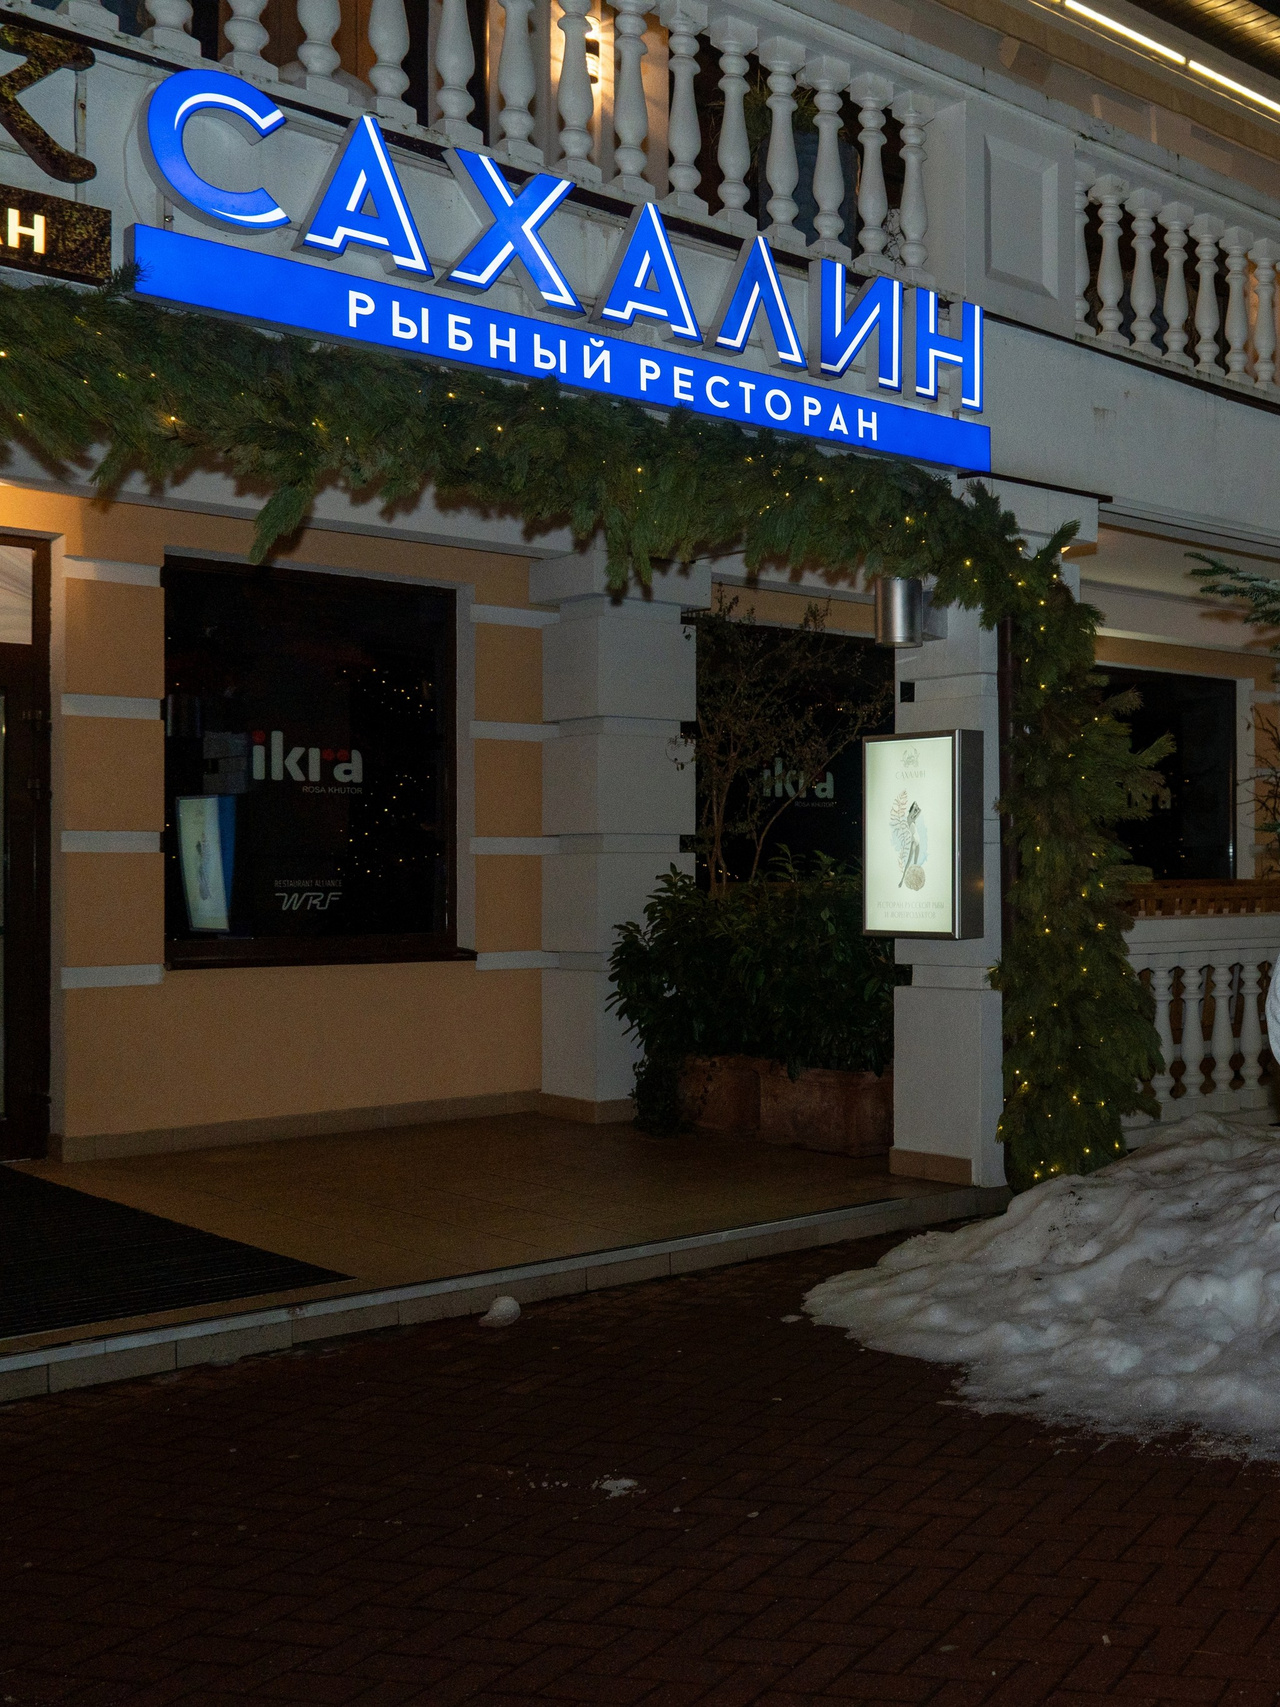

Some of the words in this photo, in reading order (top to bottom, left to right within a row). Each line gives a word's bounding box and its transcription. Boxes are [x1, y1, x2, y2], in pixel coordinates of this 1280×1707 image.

[144, 69, 983, 414] САХАЛИН
[348, 290, 612, 384] РЫБНЫЙ
[640, 357, 878, 441] РЕСТОРАН
[252, 730, 363, 783] ikra
[302, 785, 326, 794] ROSA
[328, 786, 363, 795] KHUTOR
